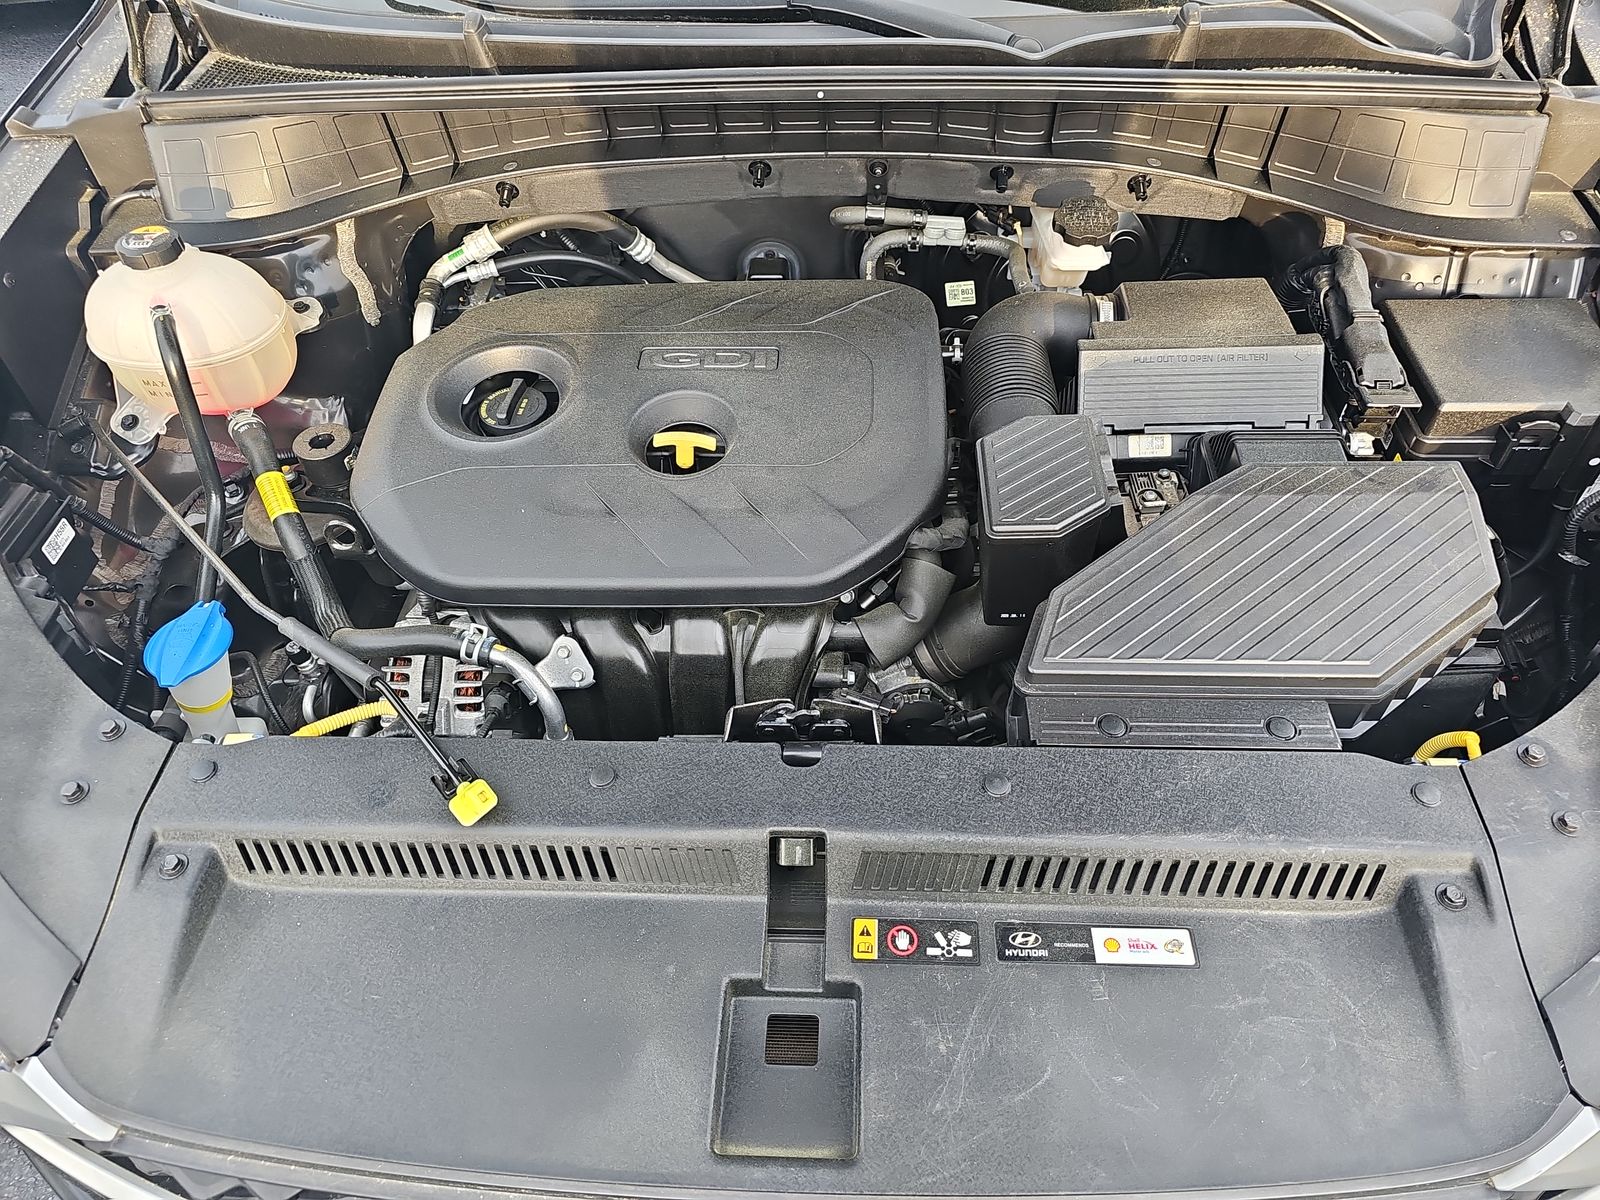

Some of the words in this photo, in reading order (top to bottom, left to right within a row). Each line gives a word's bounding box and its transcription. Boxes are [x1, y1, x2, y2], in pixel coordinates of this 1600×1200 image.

[961, 288, 974, 296] 803
[652, 351, 767, 369] GDI
[1133, 356, 1155, 364] PULL
[1157, 355, 1174, 363] OUT
[1176, 354, 1188, 363] TO
[1190, 354, 1213, 363] OPEN
[141, 379, 167, 388] MAX
[148, 390, 174, 398] MIN
[1005, 949, 1049, 957] HYUNDAI
